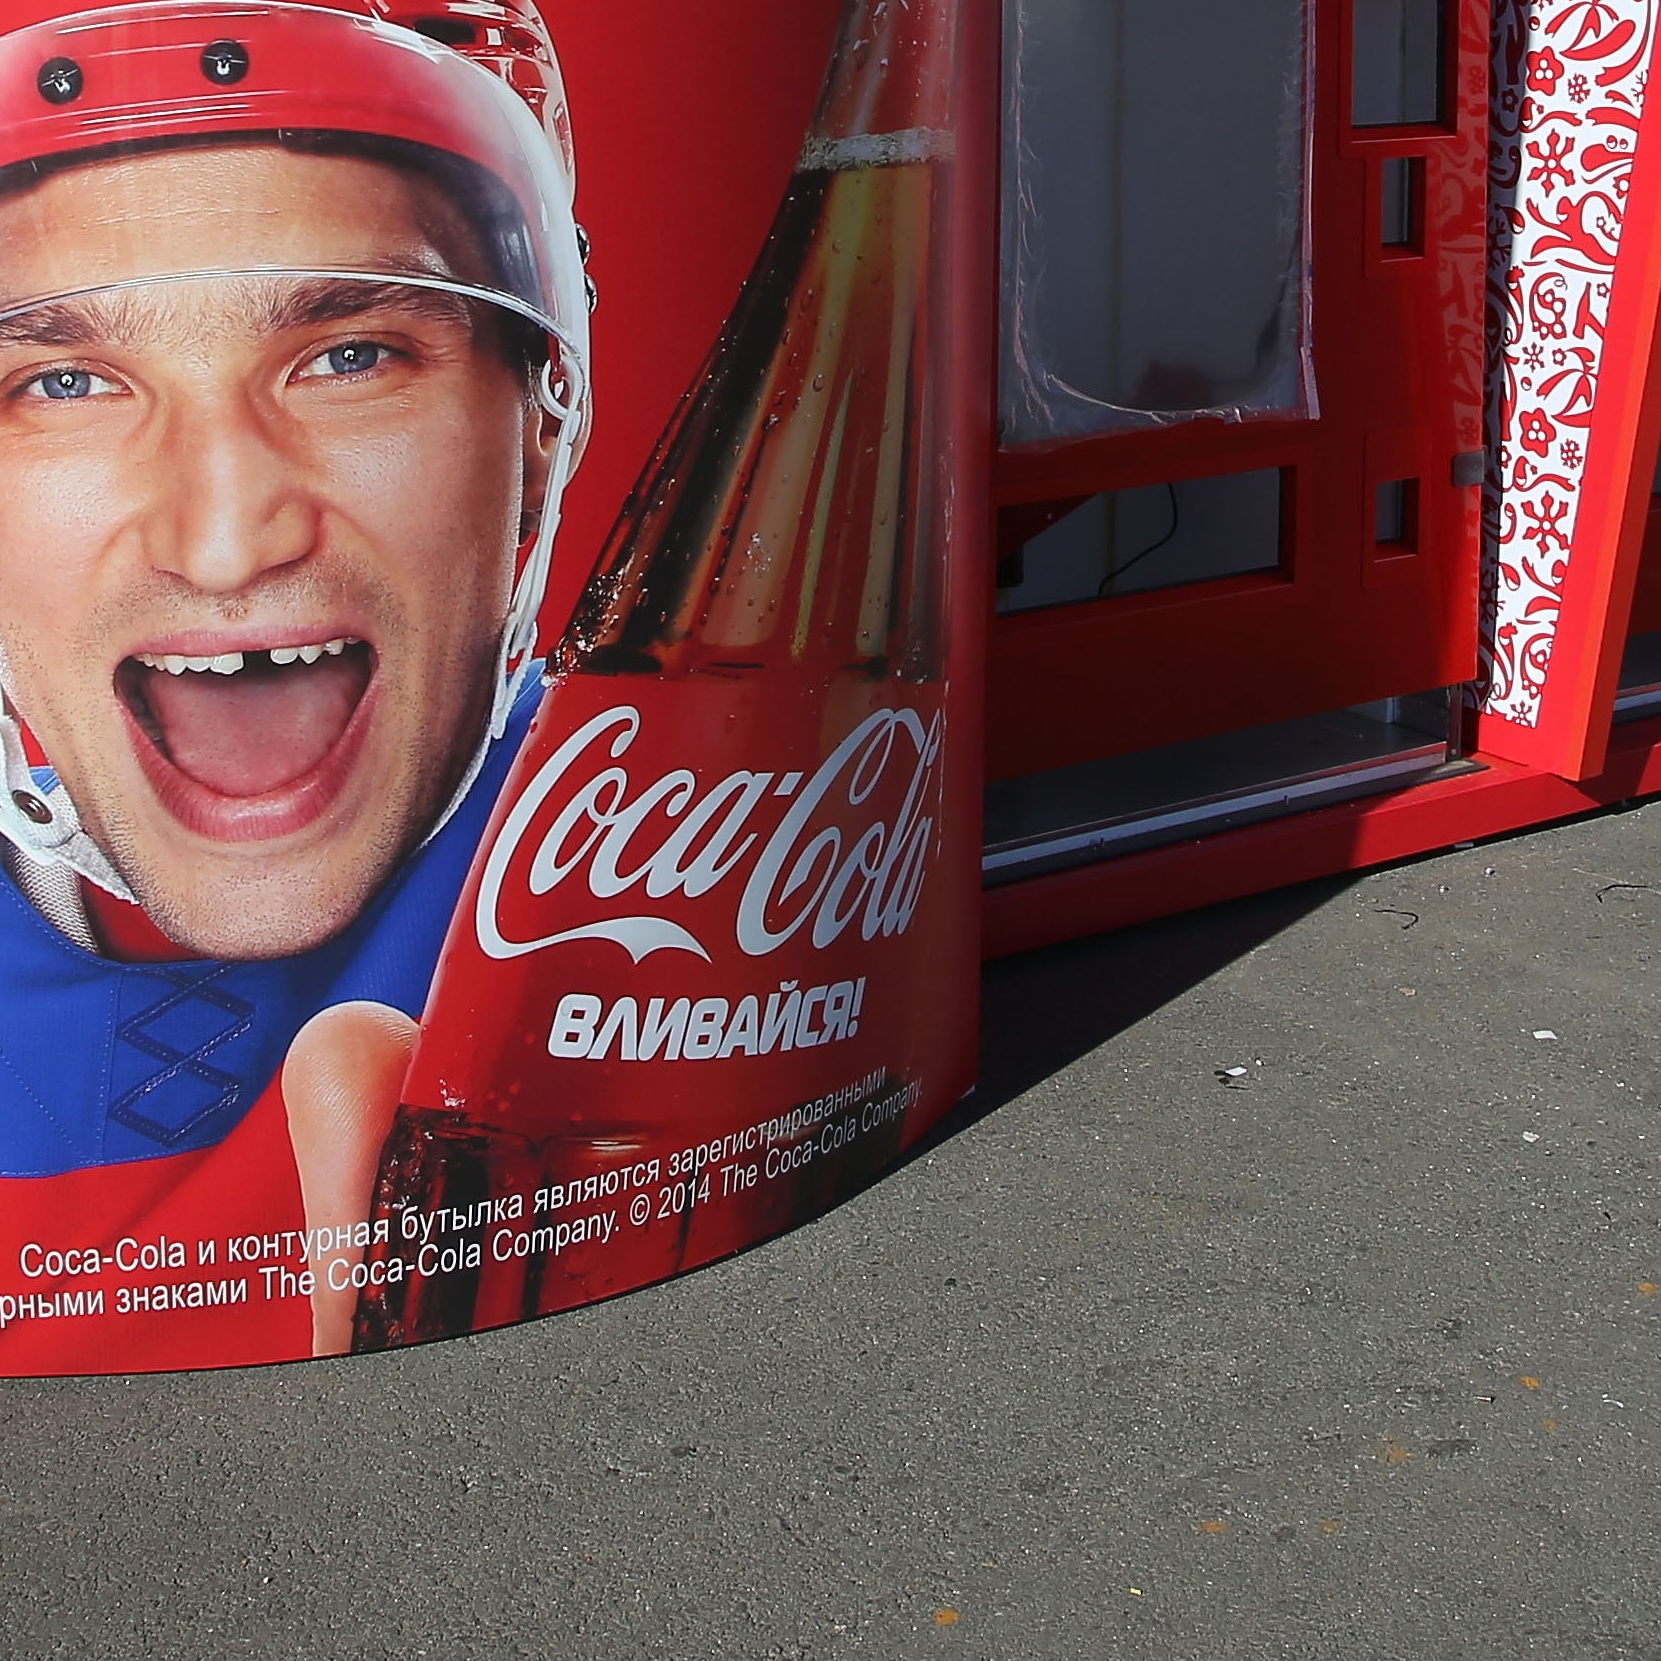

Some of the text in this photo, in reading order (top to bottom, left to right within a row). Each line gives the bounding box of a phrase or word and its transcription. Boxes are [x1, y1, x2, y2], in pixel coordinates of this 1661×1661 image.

[475, 705, 939, 965] Coca-Cola
[548, 976, 866, 1061] ВЛИВАЙСЯ!
[19, 1065, 886, 1277] Coca-Cola и контурная бутылка являются зарегистрированными
[115, 1277, 247, 1313] знаками
[258, 1264, 316, 1300] The
[328, 1237, 481, 1291] Coca-Cola
[492, 1209, 621, 1262] Company.
[658, 1172, 712, 1221] 2014
[721, 1154, 758, 1200] The
[765, 1119, 856, 1181] Coca-Cola
[861, 1075, 924, 1136] Company.
